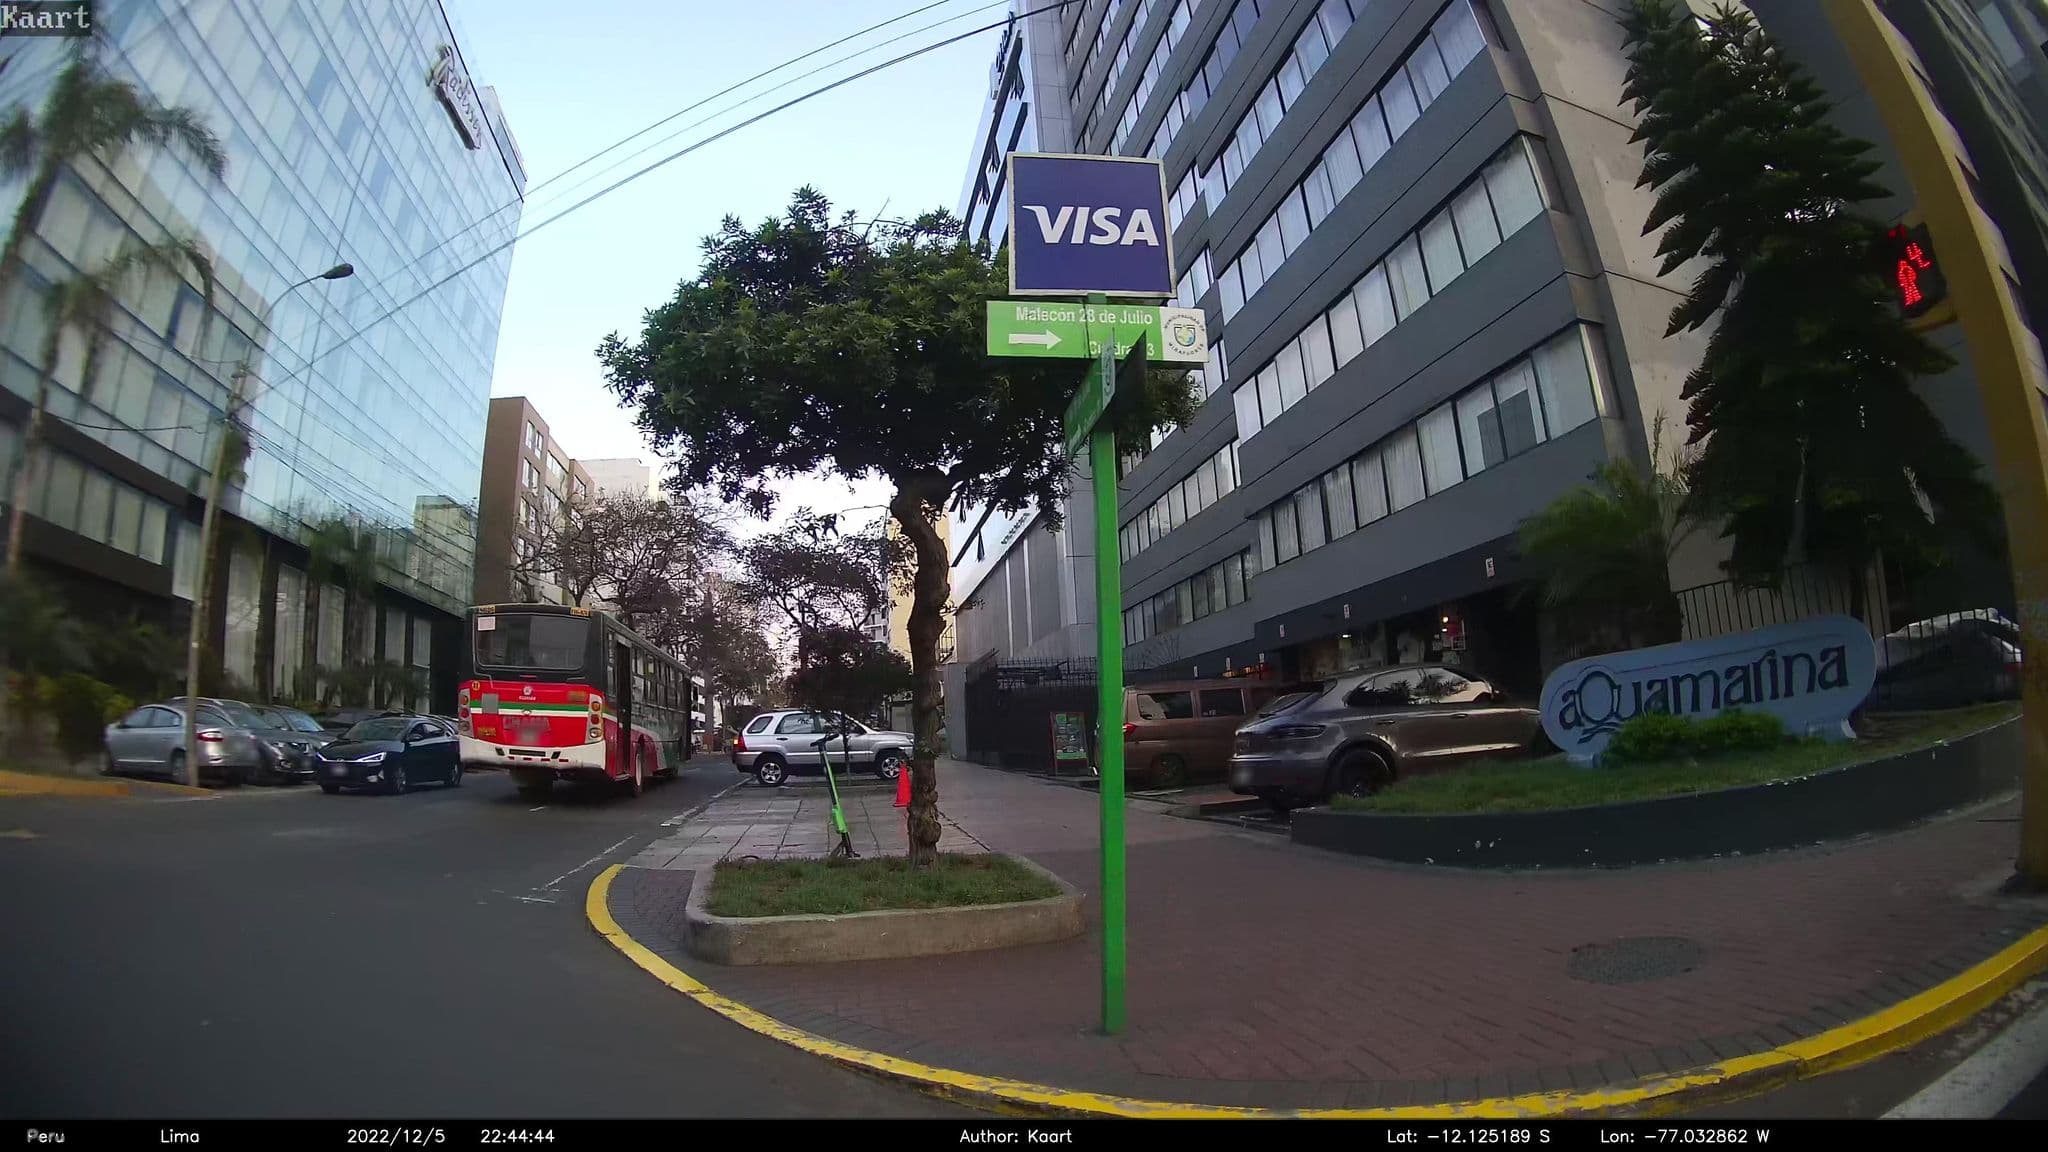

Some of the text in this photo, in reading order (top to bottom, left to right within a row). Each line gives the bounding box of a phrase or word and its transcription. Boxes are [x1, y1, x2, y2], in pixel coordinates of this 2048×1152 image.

[1021, 205, 1160, 247] VISA
[1079, 308, 1096, 322] 28
[1099, 309, 1117, 323] de
[1119, 310, 1154, 325] Julio
[1089, 340, 1155, 356] Cudr 3
